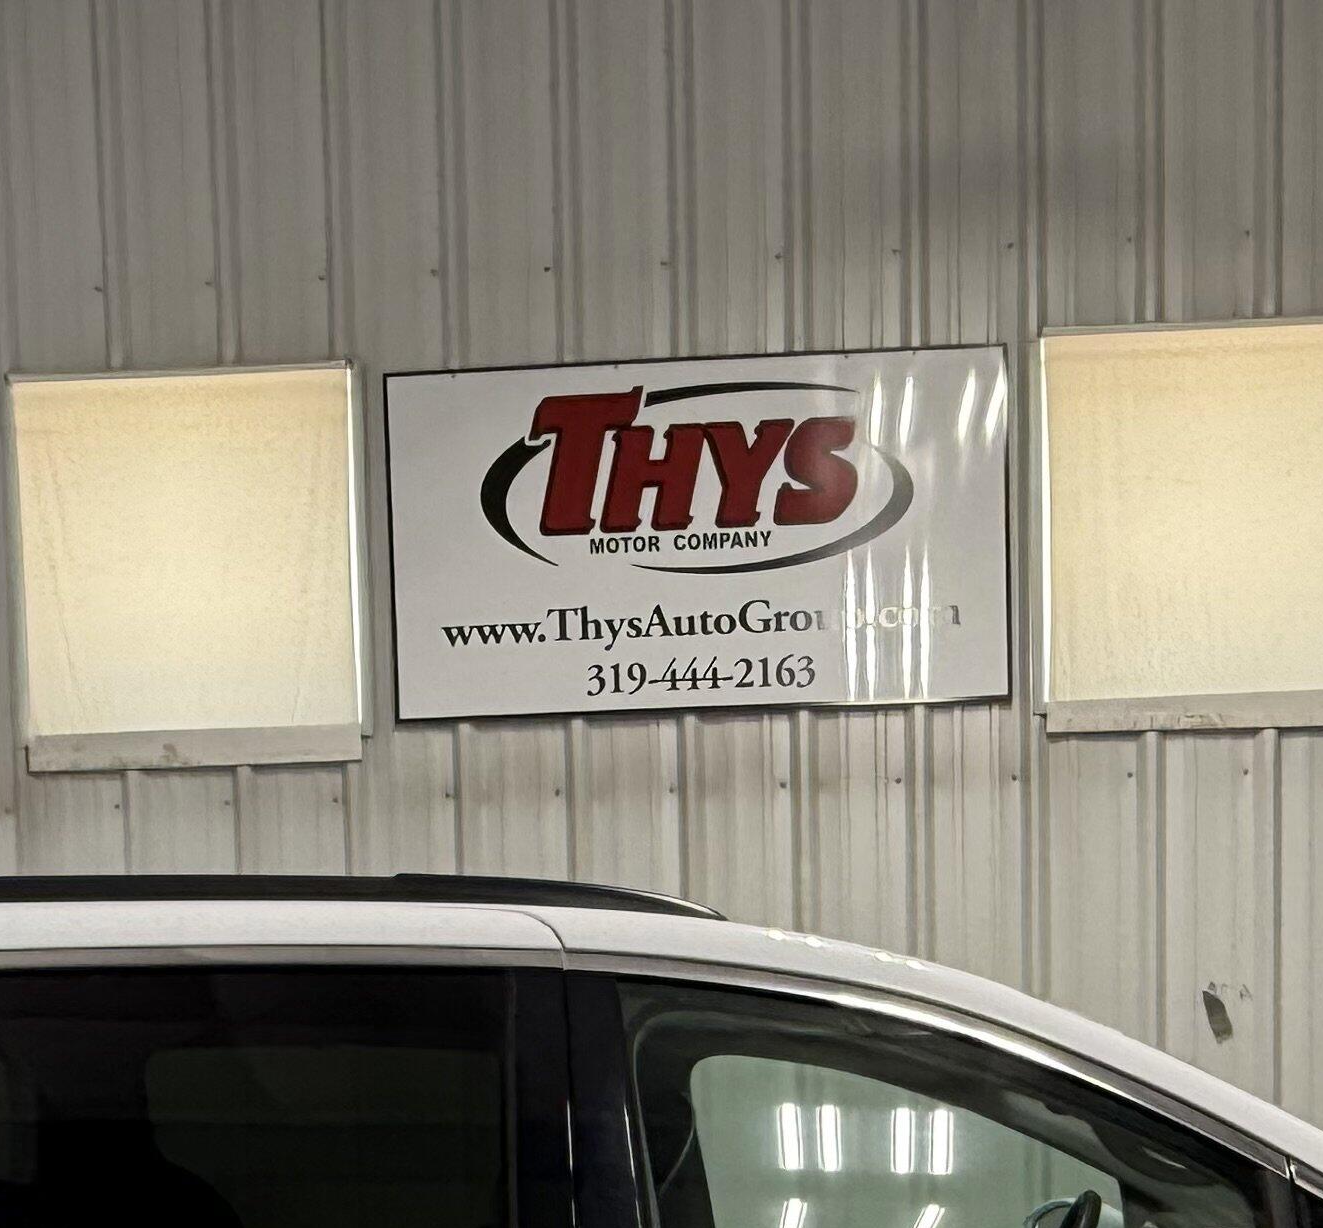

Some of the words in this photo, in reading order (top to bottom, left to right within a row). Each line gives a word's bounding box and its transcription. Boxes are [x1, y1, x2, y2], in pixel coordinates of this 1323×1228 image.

[529, 385, 859, 535] THYS
[589, 534, 661, 556] MOTOR
[673, 530, 772, 552] COMPANY
[586, 655, 816, 696] 319-444-2163
